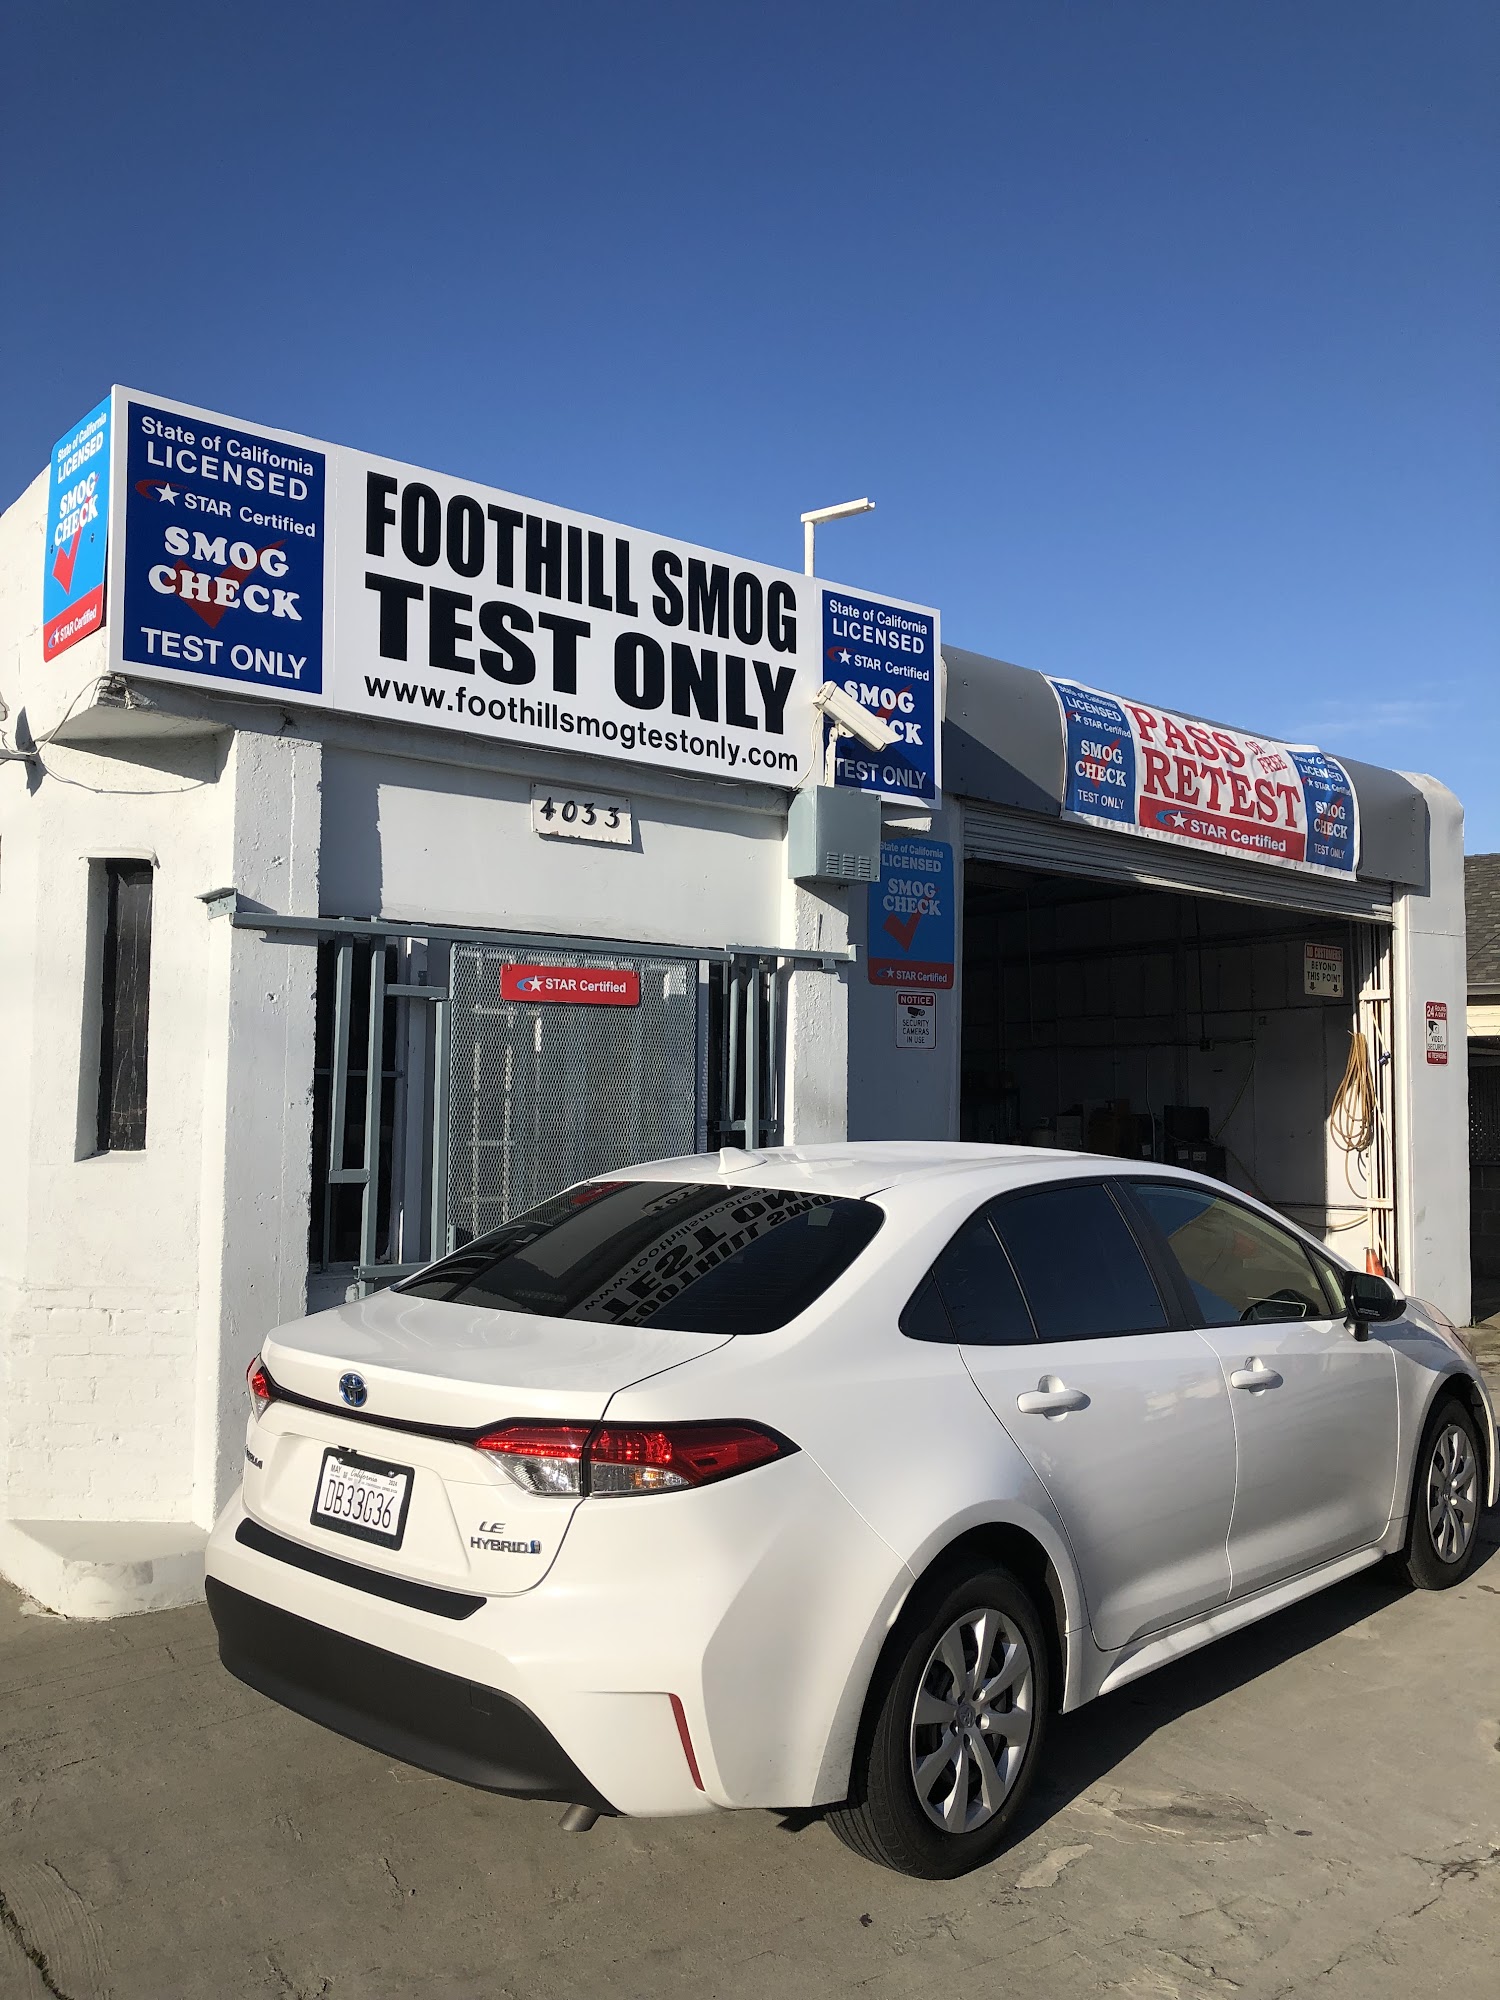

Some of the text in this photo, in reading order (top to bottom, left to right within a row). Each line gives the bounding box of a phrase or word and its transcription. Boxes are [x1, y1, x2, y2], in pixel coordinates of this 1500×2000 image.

[57, 412, 107, 464] State of California
[141, 415, 314, 477] State of California
[57, 431, 104, 484] LICENSED
[147, 441, 308, 501] LICENSED
[59, 471, 97, 519] SMOG
[54, 494, 99, 547] CHECK
[184, 493, 316, 537] STAR Certified
[164, 526, 290, 578] SMOG
[365, 470, 797, 655] FOOTHILL SMOG
[148, 564, 303, 621] CHECK
[59, 605, 97, 643] STAR Certified
[829, 600, 928, 635] State of California
[832, 618, 925, 655] LICENSED
[140, 627, 308, 680] TEST ONLY
[365, 571, 797, 735] TEST ONLY
[854, 654, 930, 681] STAR Certified
[844, 680, 915, 714] SMOG
[1077, 691, 1085, 699] of
[1065, 695, 1122, 722] LICENSED
[364, 675, 798, 772] www.foothillsmogtestonly.com
[1083, 716, 1132, 738] STAR Certified
[1124, 703, 1245, 768] PASS
[1080, 739, 1123, 765] SMOG
[1244, 741, 1265, 756] OR
[1257, 754, 1288, 774] FREE
[1308, 756, 1315, 765] of
[836, 757, 927, 790] TEST ONLY
[1075, 760, 1127, 787] CHECK
[1141, 746, 1301, 828] RETEST
[1314, 781, 1331, 792] STAR
[1077, 789, 1124, 810] TEST ONLY
[1315, 800, 1346, 820] SMOG
[540, 796, 620, 829] 4033
[1190, 819, 1286, 852] STAR Certified
[1313, 818, 1348, 840] CHECK
[880, 840, 944, 858] State of California
[1314, 843, 1345, 860] TEST ONLY
[881, 853, 942, 873] LICENSED
[888, 878, 936, 898] SMOG
[882, 895, 941, 916] CHECK
[896, 970, 947, 983] STAR Certified
[1307, 971, 1341, 983] THIS POINT
[1311, 960, 1337, 972] BEYOND
[545, 978, 627, 993] STAR Certified
[900, 995, 932, 1005] NOTICE
[1427, 1005, 1434, 1018] 24
[902, 1019, 929, 1028] SECURITY
[902, 1027, 929, 1036] CAMERAS
[907, 1036, 925, 1044] IN USE
[1427, 1043, 1447, 1051] SECURITY
[1431, 1035, 1443, 1043] VIDEO
[330, 1464, 343, 1474] MAY
[350, 1468, 378, 1484] California
[324, 1479, 395, 1529] DB33G36
[479, 1521, 507, 1534] LE
[470, 1536, 529, 1554] HYBRID
